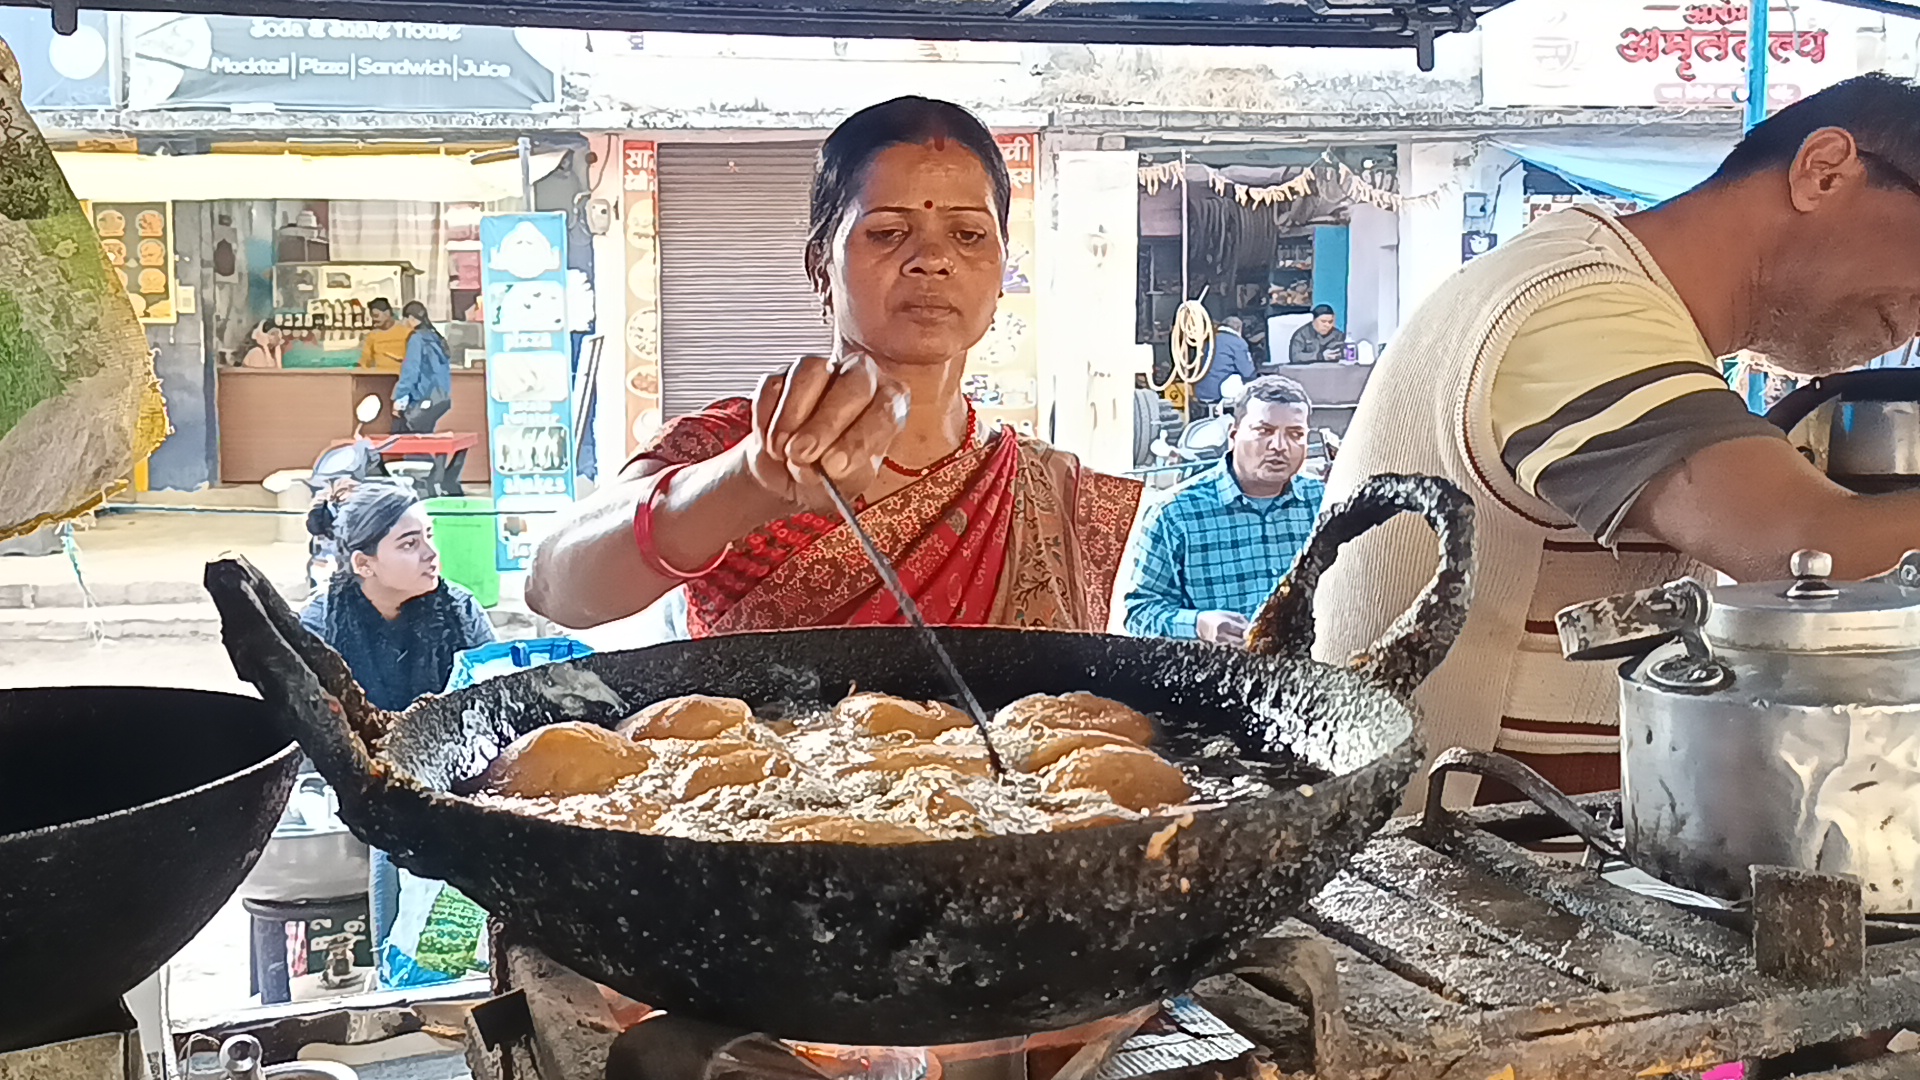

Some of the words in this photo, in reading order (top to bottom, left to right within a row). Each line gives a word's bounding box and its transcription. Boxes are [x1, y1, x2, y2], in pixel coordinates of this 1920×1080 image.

[249, 18, 304, 38] Soda
[394, 22, 462, 41] House
[211, 56, 290, 75] Mocktail
[298, 57, 349, 75] Pizza
[357, 57, 452, 76] Sandwich
[457, 59, 511, 78] Juice
